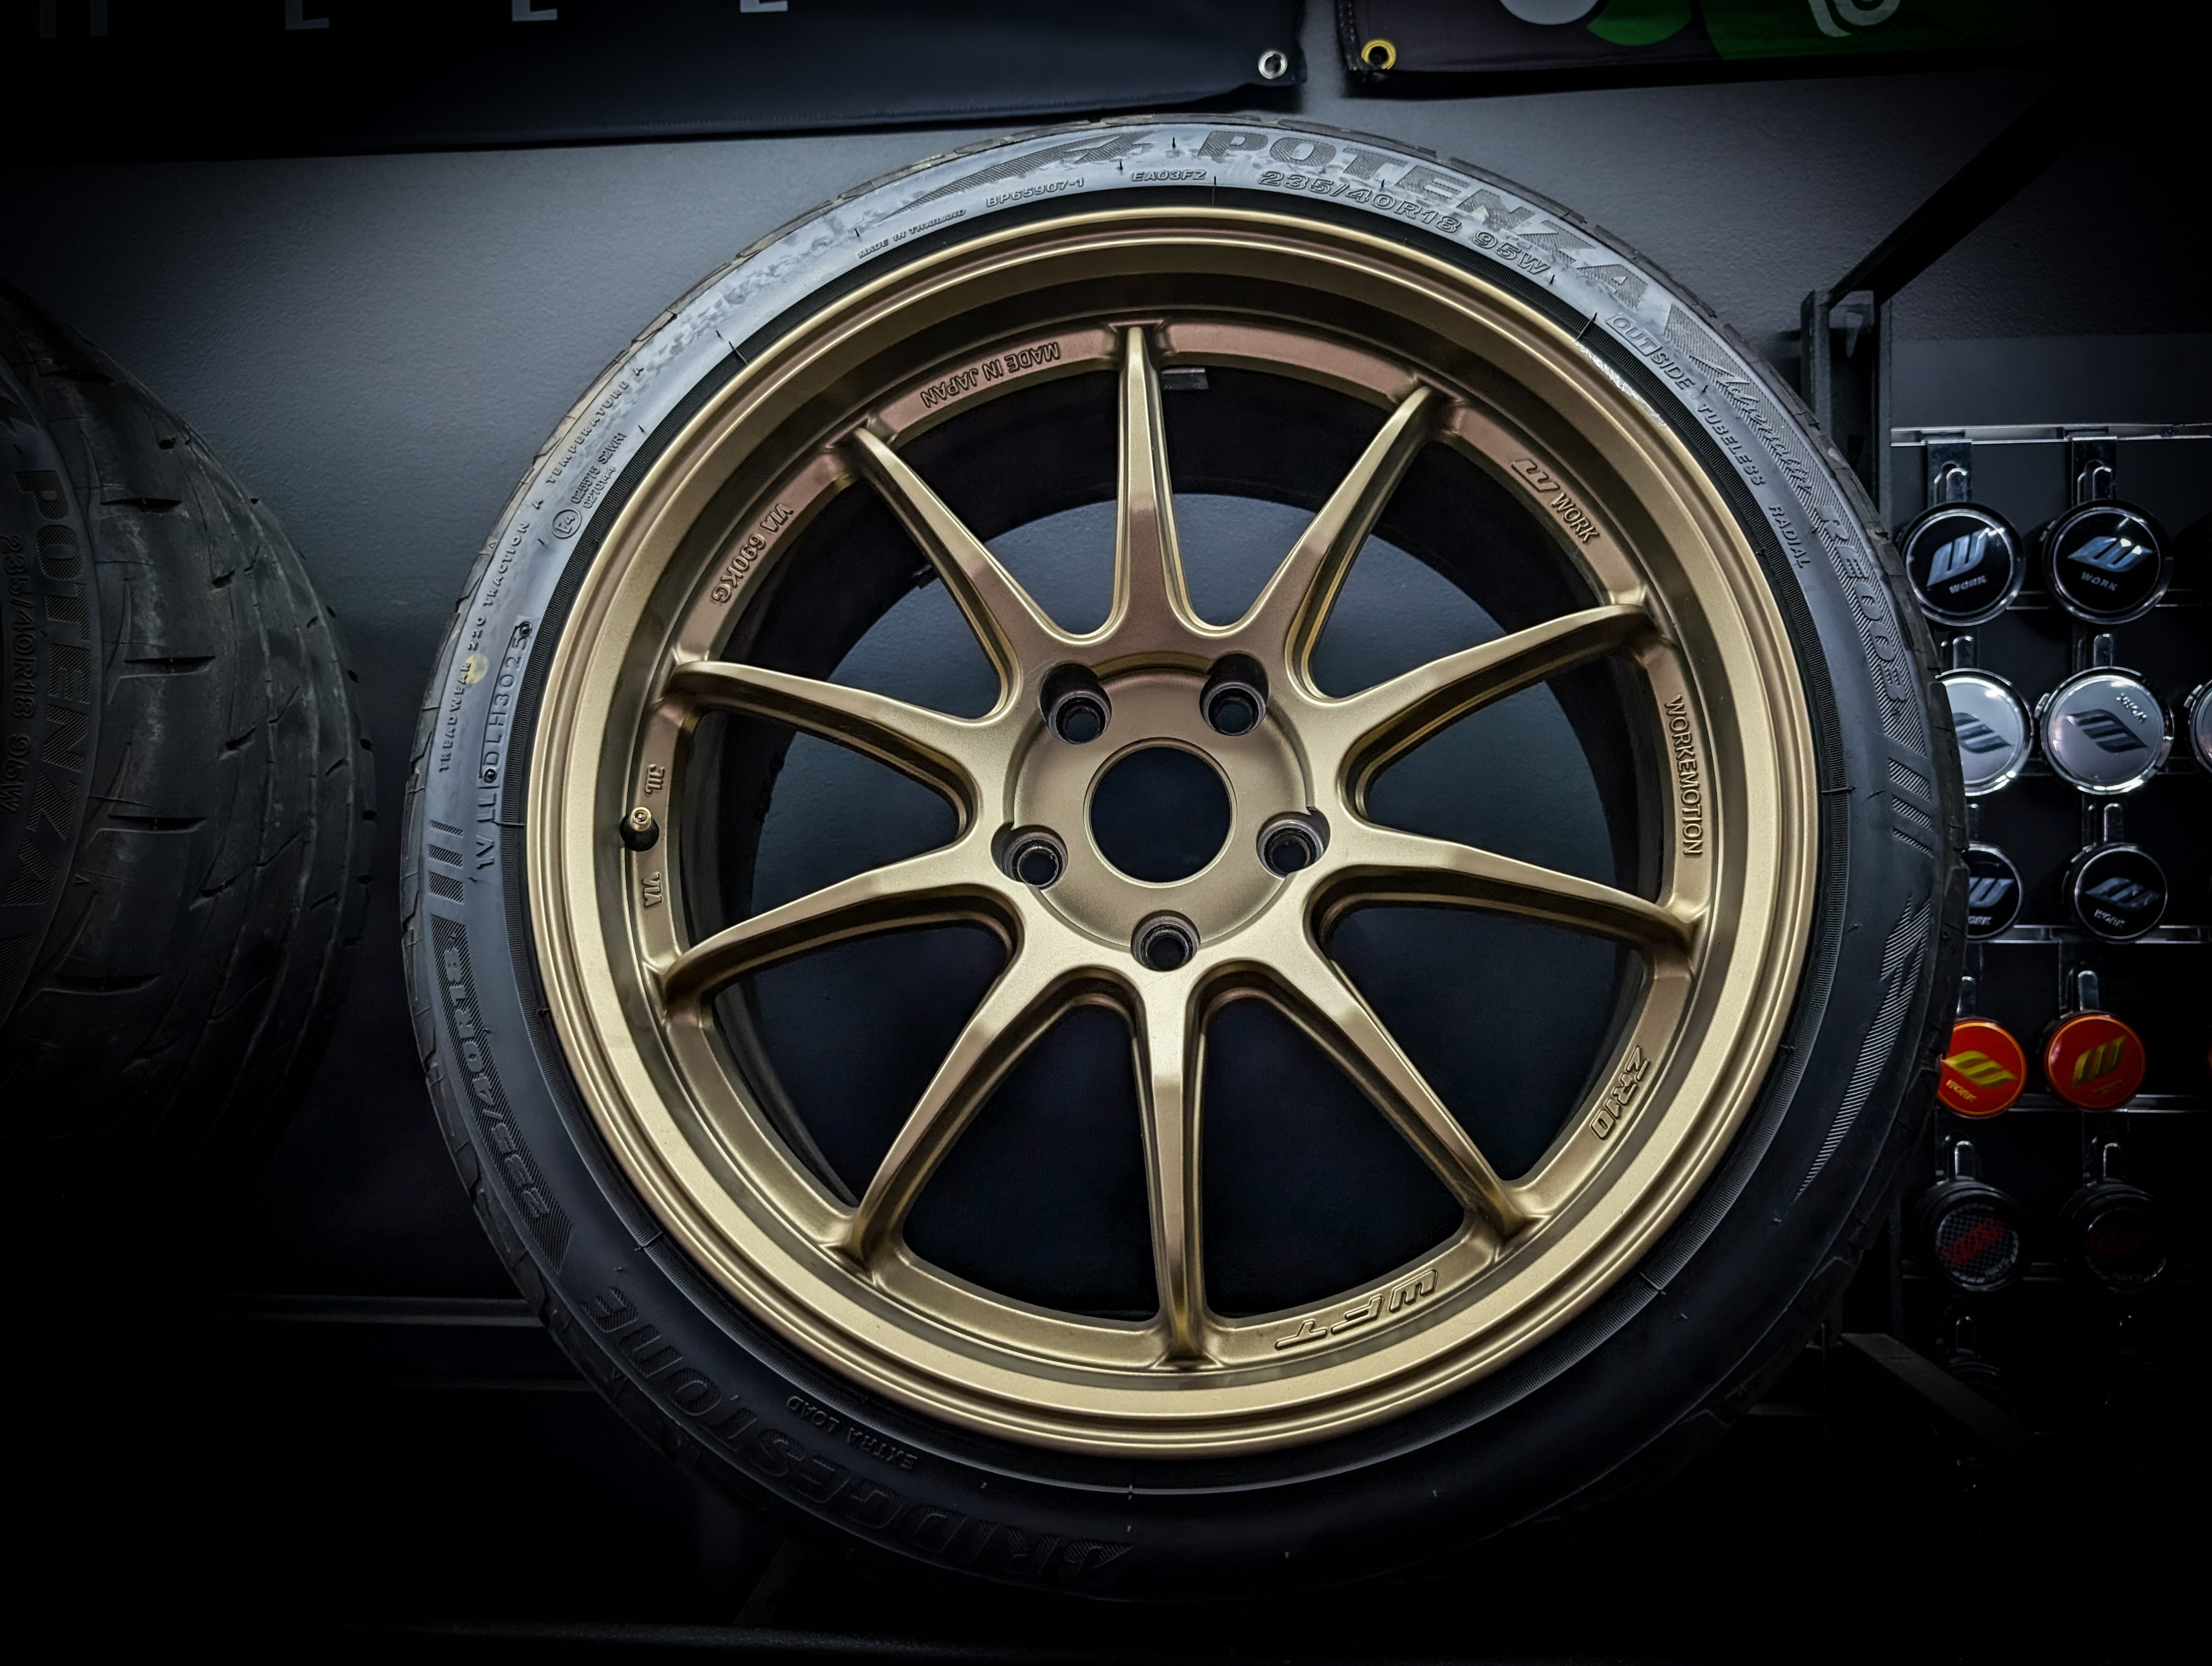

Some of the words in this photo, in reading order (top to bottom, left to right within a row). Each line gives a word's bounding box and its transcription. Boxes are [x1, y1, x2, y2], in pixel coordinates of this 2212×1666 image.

[986, 177, 1085, 208] BP65907-1
[858, 239, 889, 259] MADE
[893, 230, 906, 241] IN
[909, 208, 966, 235] THAILAND
[1197, 130, 1648, 310] POTENZA
[1257, 170, 1462, 234] 235/40R18
[1472, 231, 1551, 275] 95W
[982, 360, 1003, 381] IN
[1006, 342, 1060, 372] MADE
[921, 368, 979, 408] JAPAN
[1607, 313, 1695, 389] OUTSIDE
[1698, 404, 1766, 486] TUBELESS
[1768, 504, 1813, 569] RADIAL
[760, 503, 794, 533] VIA
[1551, 492, 1599, 543] WORK
[439, 662, 472, 772] TREADWEAR
[467, 616, 486, 652] 220
[484, 521, 529, 607] TRACTION
[532, 499, 544, 510] A
[546, 380, 629, 485] TEMPERATURE
[632, 365, 645, 376] A
[711, 533, 766, 604] 690KG
[1949, 575, 1988, 594] WORK
[2081, 572, 2118, 591] WORK
[1814, 504, 1906, 702] RE003
[3, 470, 91, 906] POTENZA
[1664, 694, 1703, 856] WORKEMOTION
[443, 947, 549, 1220] 235/40R18
[1591, 1045, 1650, 1140] ZR10
[786, 1394, 839, 1432] LOAD
[846, 1427, 918, 1471] EXTRA
